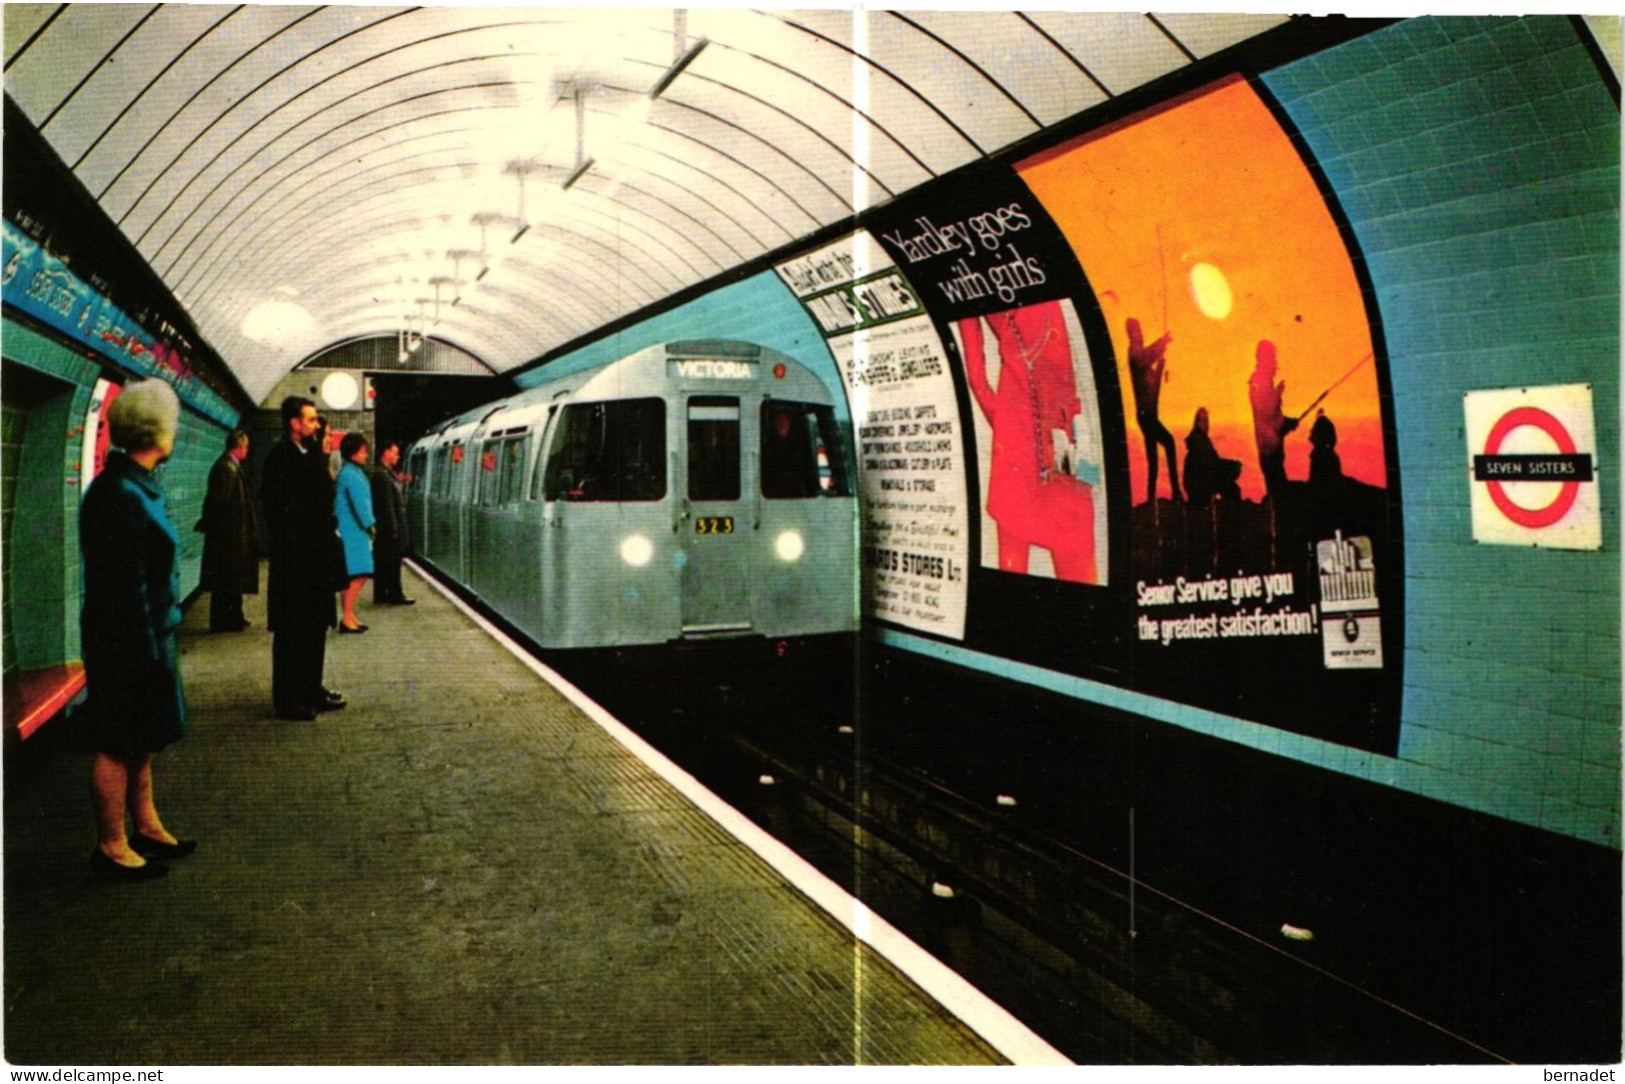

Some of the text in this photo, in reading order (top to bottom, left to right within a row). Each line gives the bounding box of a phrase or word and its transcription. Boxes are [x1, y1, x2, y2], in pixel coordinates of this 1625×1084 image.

[882, 203, 1032, 263] Yardley goes
[938, 243, 1046, 303] with girls
[676, 360, 752, 379] VICTORIA
[1486, 461, 1576, 474] SEVEN SISTERS
[697, 516, 733, 536] 323
[902, 552, 943, 579] STORES
[1137, 569, 1294, 606] Senior Service give you
[1138, 603, 1319, 646] the greatest satisfaction!
